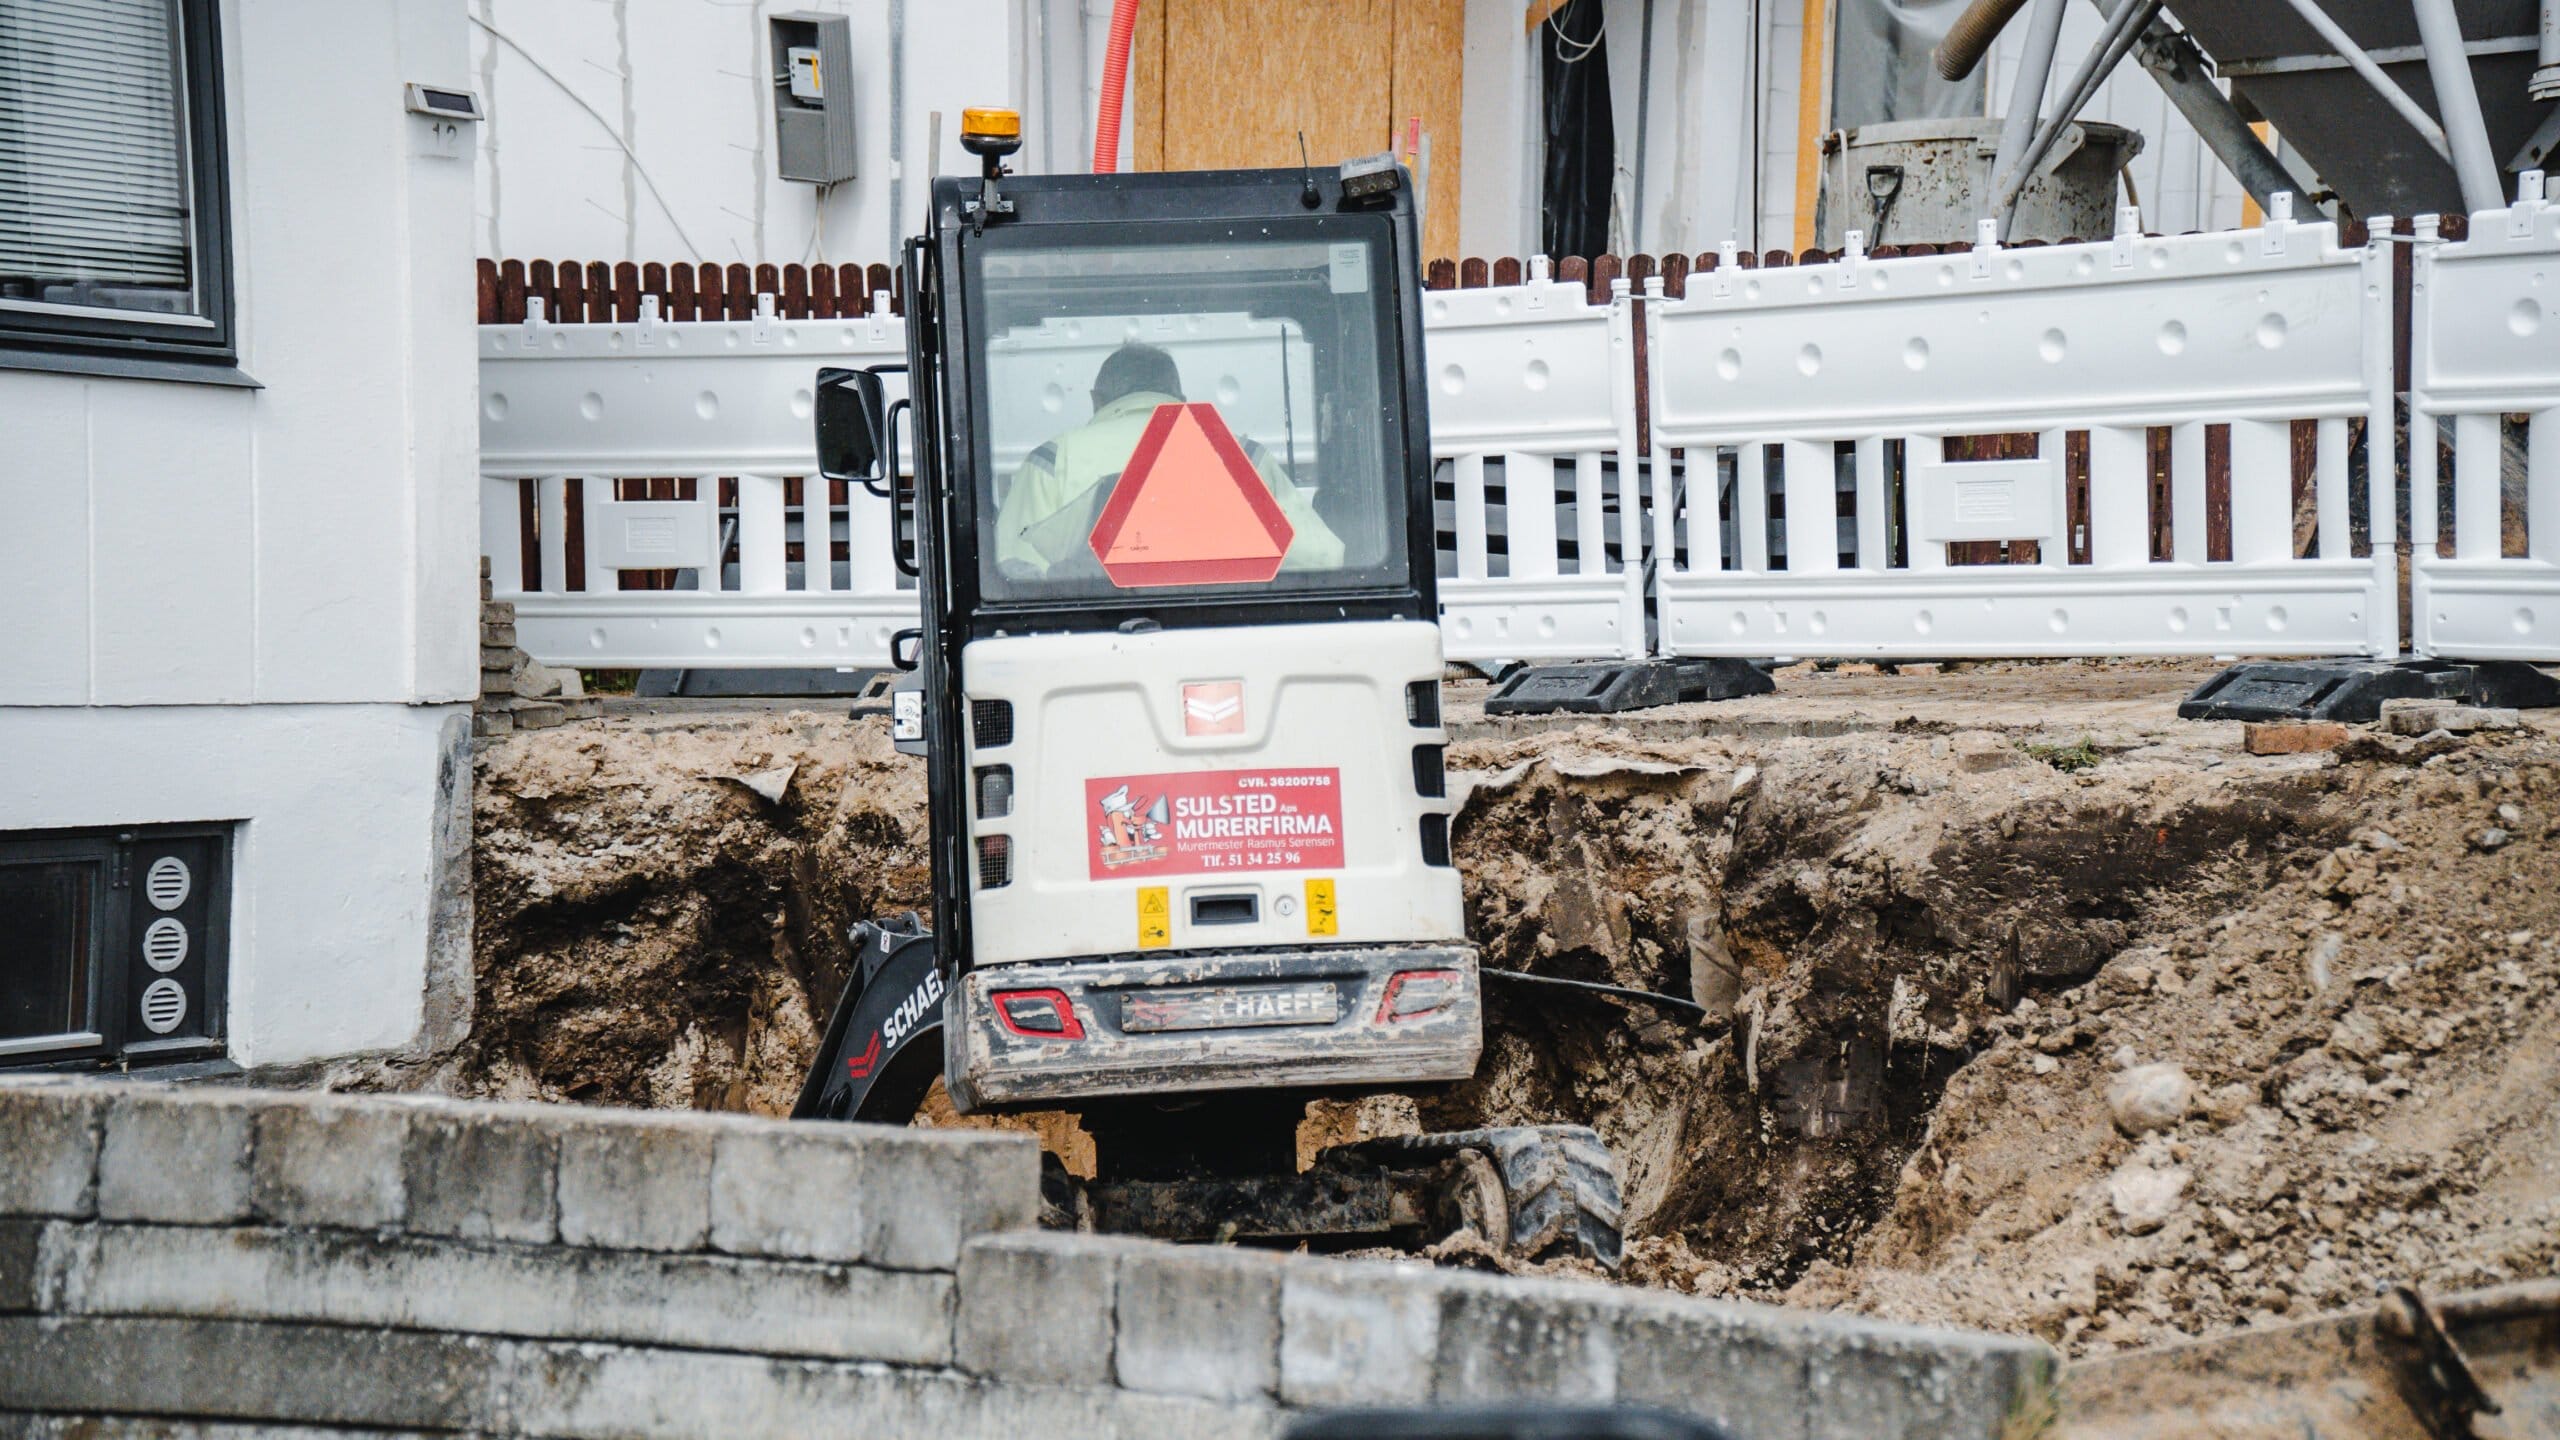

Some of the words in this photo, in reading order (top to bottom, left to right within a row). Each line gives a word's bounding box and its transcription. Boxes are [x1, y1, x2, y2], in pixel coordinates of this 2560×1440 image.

[1238, 777, 1268, 788] CVR.
[1269, 775, 1331, 787] 36200758
[1175, 793, 1276, 817] SULSTED
[1279, 803, 1298, 814] Aps
[1176, 813, 1334, 839] MURERFIRMA
[1177, 839, 1244, 853] Murermester
[1247, 837, 1287, 849] Rasmus
[1288, 836, 1335, 848] Sørensen
[1201, 853, 1225, 867] Tlf.
[1228, 853, 1243, 866] 51
[1247, 852, 1263, 866] 34
[1266, 851, 1282, 865] 25
[1285, 850, 1301, 865] 96
